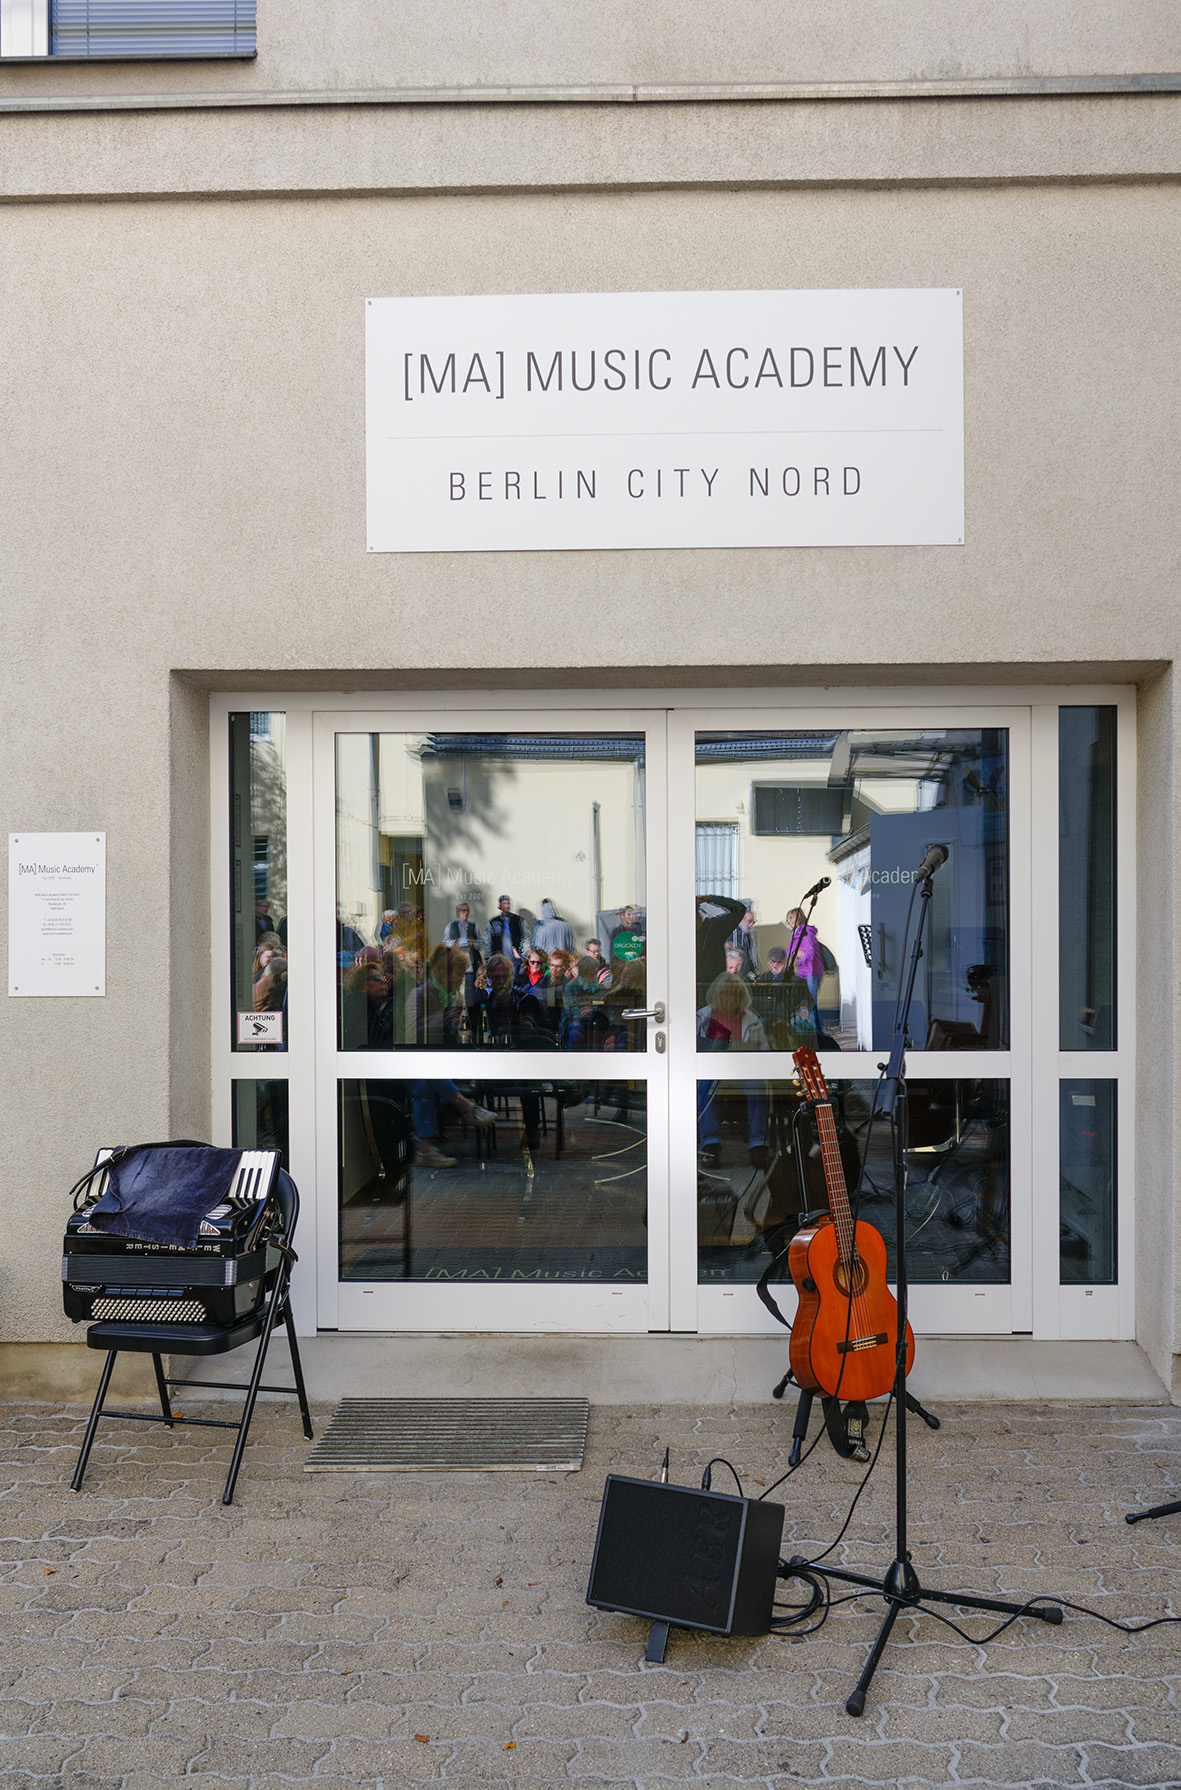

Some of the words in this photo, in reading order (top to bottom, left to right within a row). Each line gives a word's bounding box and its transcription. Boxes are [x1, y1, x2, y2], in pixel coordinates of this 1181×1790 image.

[405, 352, 504, 402] [MA]
[526, 348, 672, 392] MUSIC
[692, 345, 919, 389] ACADEMY
[449, 470, 596, 501] BERLIN
[628, 468, 719, 499] CITY
[750, 466, 861, 497] NORD
[18, 862, 37, 876] [MA]
[38, 863, 61, 874] Music
[61, 863, 96, 875] Academy
[402, 862, 441, 890] [MA]
[446, 867, 496, 886] Music
[500, 867, 577, 888] Academy
[456, 892, 467, 900] Est
[468, 892, 485, 900] 2001
[511, 1267, 603, 1278] Music
